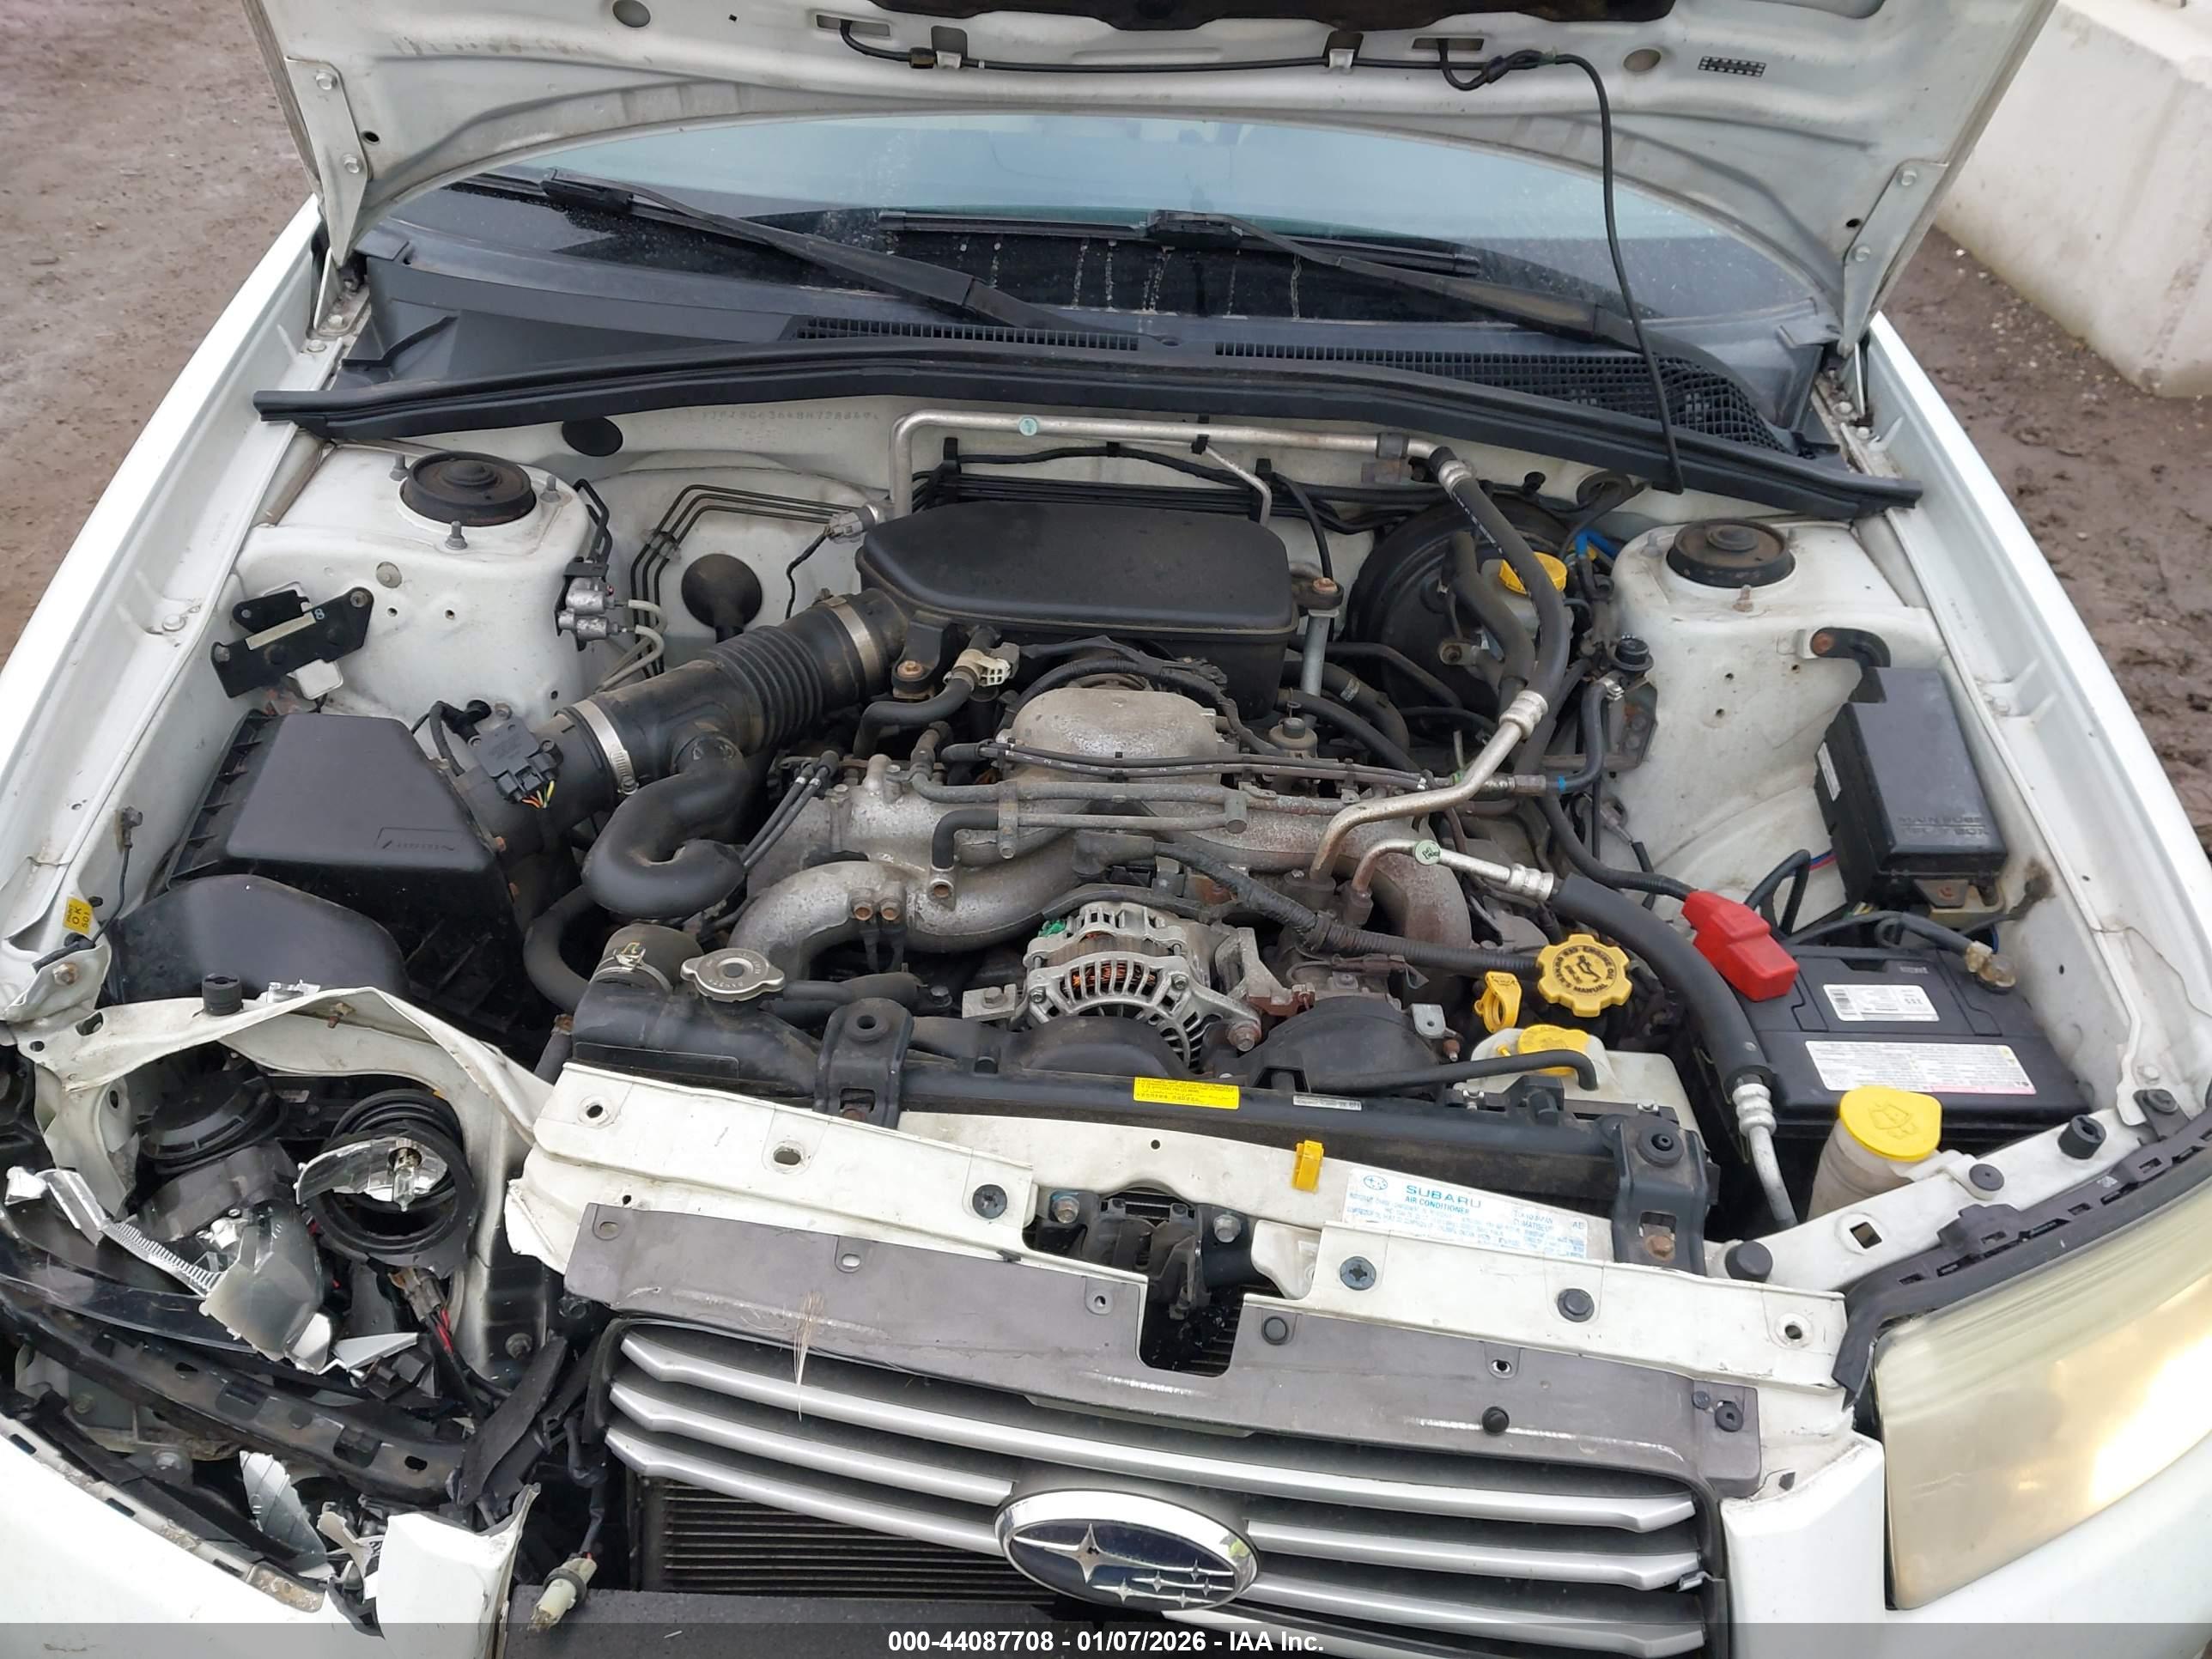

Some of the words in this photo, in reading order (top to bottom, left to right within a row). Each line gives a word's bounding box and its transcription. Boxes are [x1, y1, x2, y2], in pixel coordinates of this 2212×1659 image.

[72, 907, 82, 925] OK
[1583, 946, 1612, 966] ENGINE
[1606, 968, 1614, 980] OIL
[1573, 983, 1608, 994] MANUAL
[1405, 1195, 1418, 1204] AIR
[1419, 1198, 1470, 1214] CONDITIONER
[1406, 1184, 1481, 1209] SUBARU
